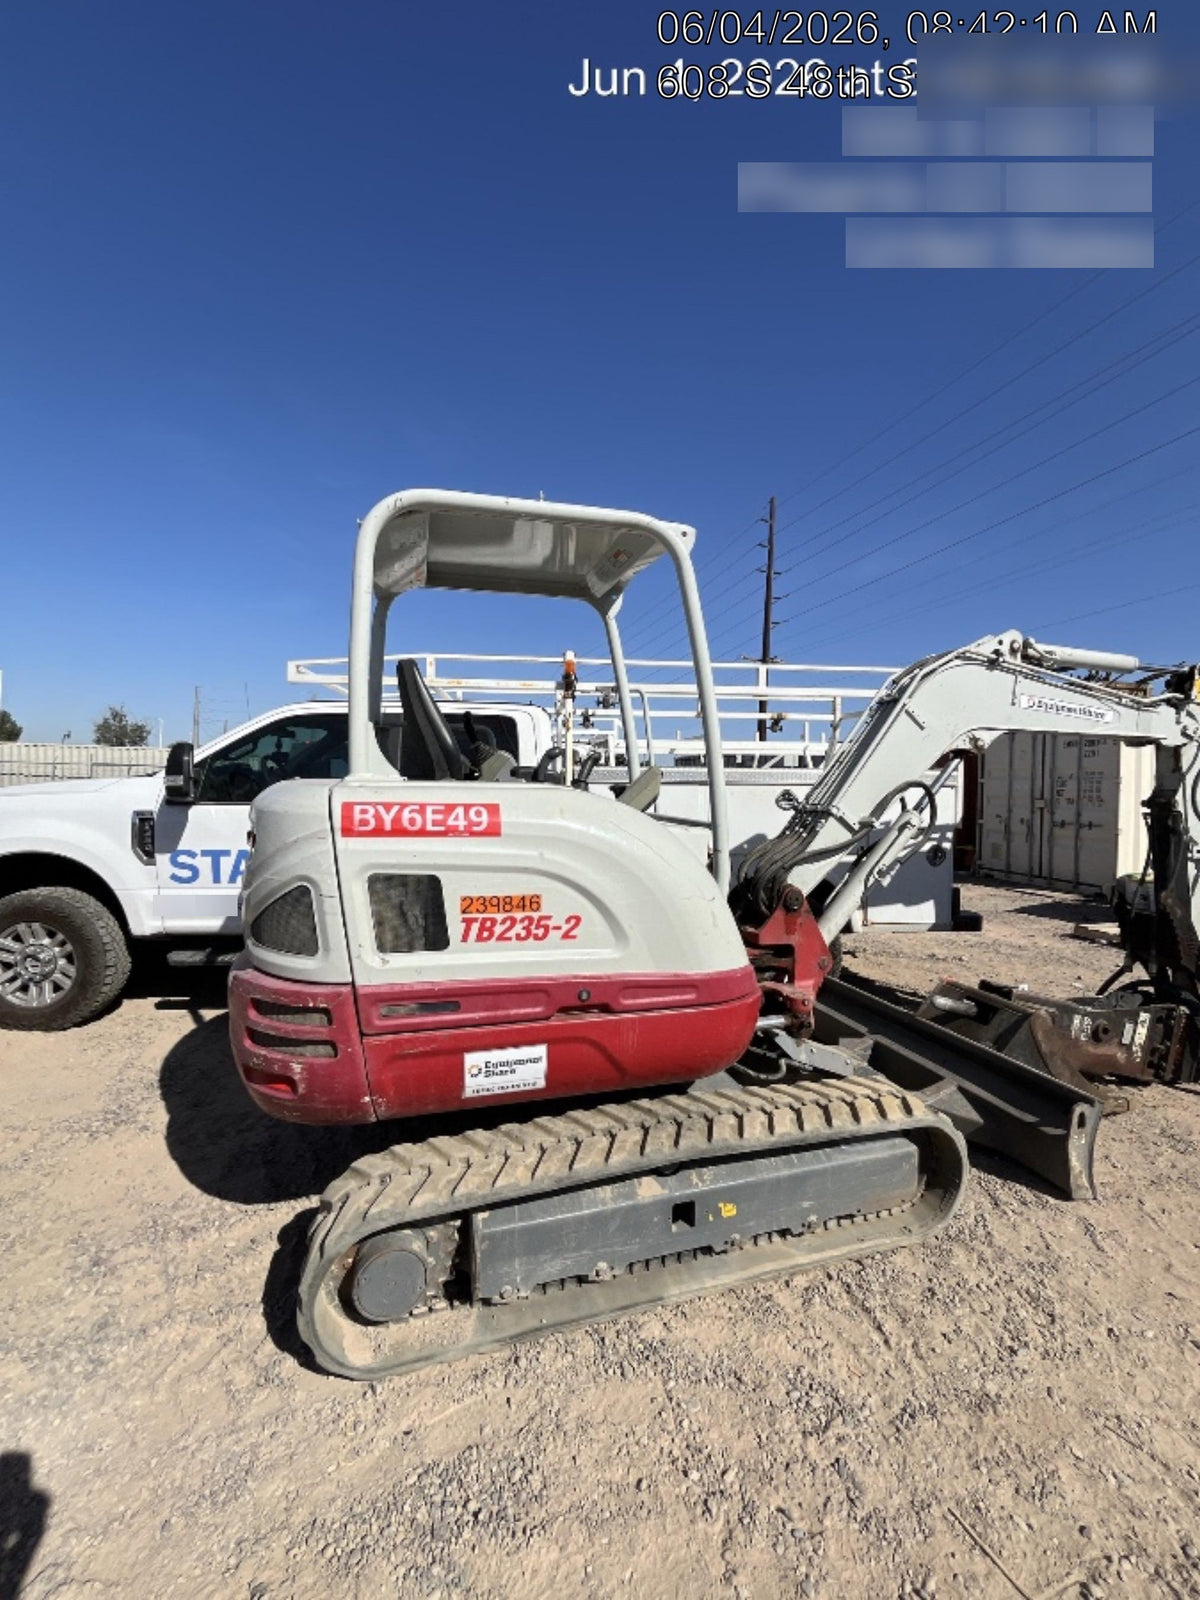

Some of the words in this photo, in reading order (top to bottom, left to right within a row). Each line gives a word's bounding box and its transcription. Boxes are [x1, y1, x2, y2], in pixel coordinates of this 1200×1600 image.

[353, 804, 489, 832] BY6E49
[461, 895, 541, 914] 239846
[460, 915, 582, 943] TB235-2
